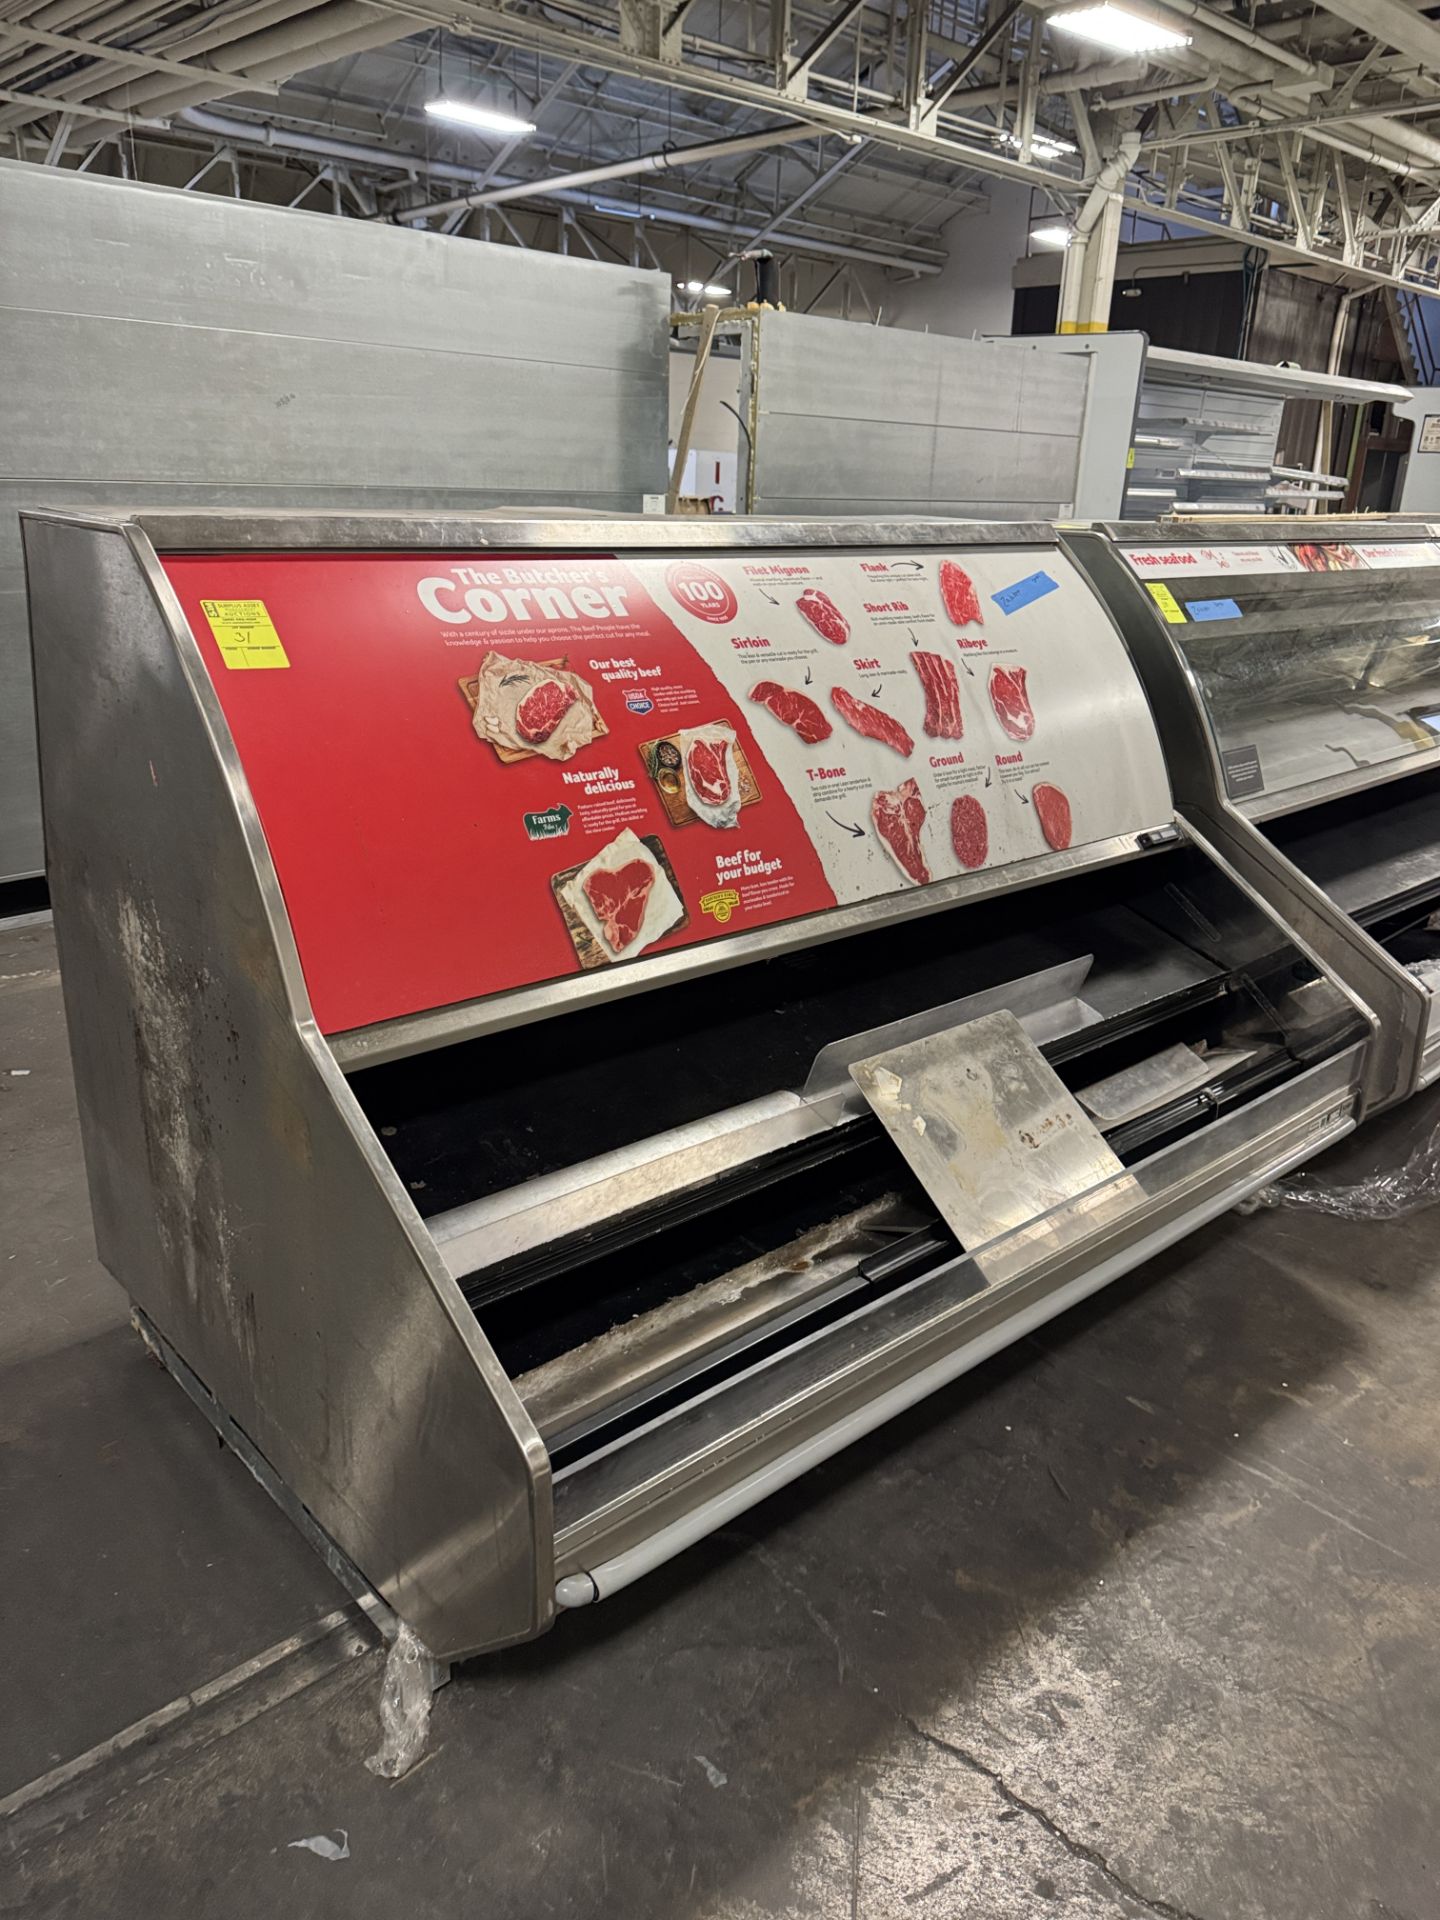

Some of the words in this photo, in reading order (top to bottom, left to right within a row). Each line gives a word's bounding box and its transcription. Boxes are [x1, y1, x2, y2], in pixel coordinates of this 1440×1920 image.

[860, 562, 889, 572] Flank
[1129, 553, 1160, 567] Fresh
[1160, 552, 1198, 565] seafood
[451, 568, 502, 585] The
[502, 567, 609, 584] Butcher's
[743, 565, 770, 576] Filet
[771, 564, 810, 577] Mignon
[678, 581, 724, 601] 100
[416, 577, 630, 624] Corner
[863, 602, 892, 613] Short
[892, 600, 909, 611] Rib
[731, 636, 770, 649] Sirloin
[957, 638, 988, 650] Ribeye
[589, 659, 611, 670] Our
[611, 657, 636, 668] best
[853, 657, 881, 670] Skirt
[602, 668, 639, 682] quality
[638, 665, 661, 676] beef
[929, 751, 965, 768] Ground
[995, 750, 1023, 766] Round
[562, 766, 619, 784] Naturally
[806, 766, 846, 781] T-Bone
[584, 780, 635, 795] delicious
[532, 813, 561, 825] Farms
[716, 851, 742, 868] Beef
[743, 849, 761, 863] for
[716, 868, 742, 886] your
[743, 858, 782, 876] budget
